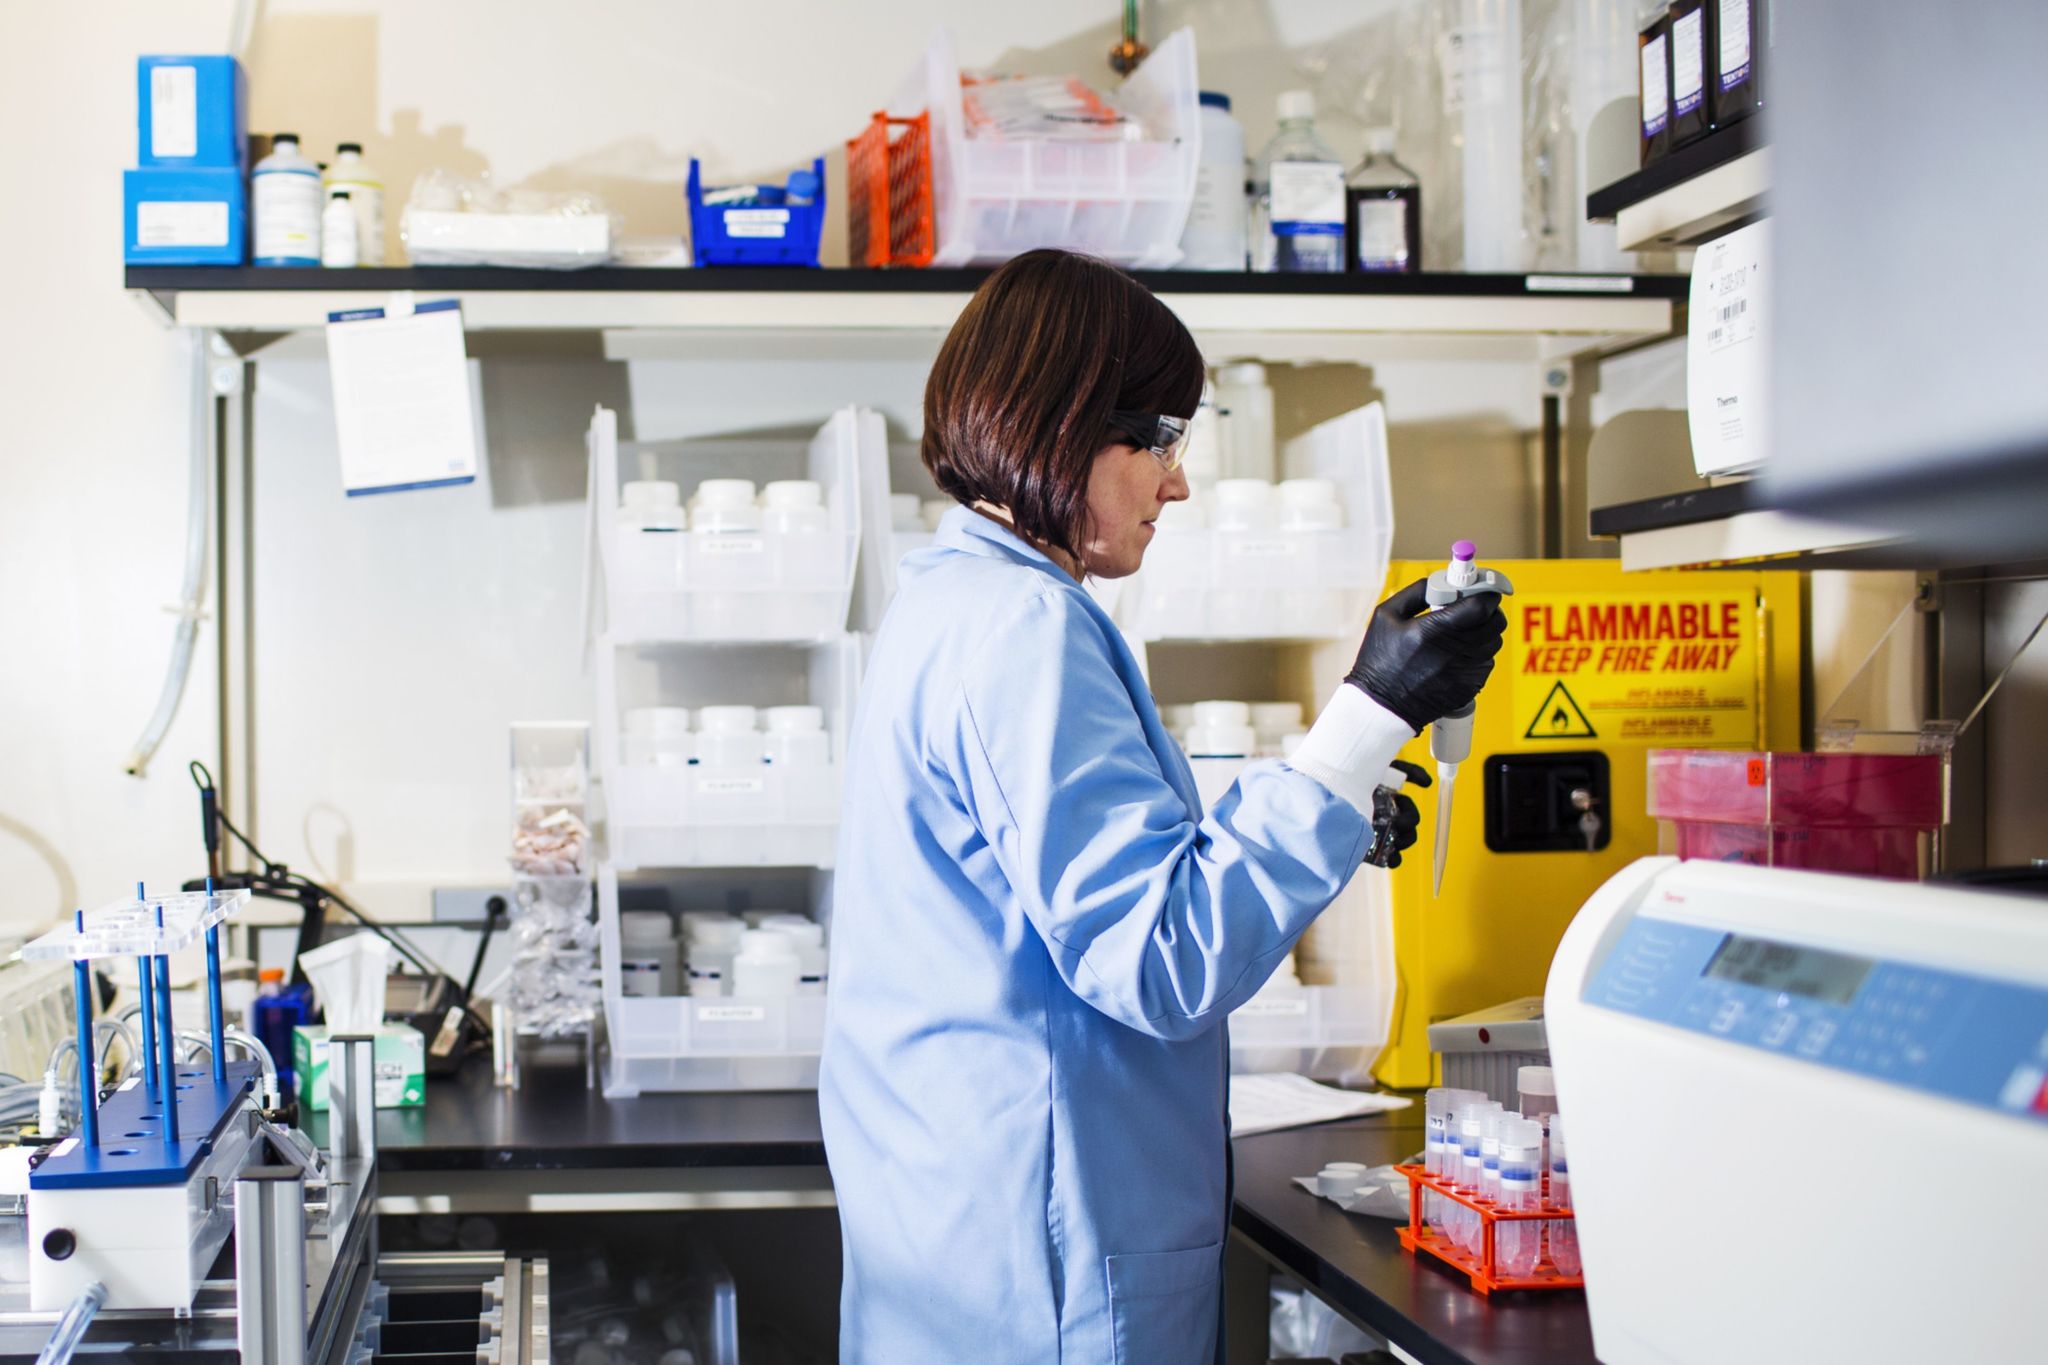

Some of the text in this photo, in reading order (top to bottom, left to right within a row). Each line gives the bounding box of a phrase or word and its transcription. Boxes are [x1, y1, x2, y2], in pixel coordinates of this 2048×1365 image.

[1522, 602, 1740, 643] FLAMMABLE
[1522, 644, 1739, 675] KEEP FIRE AWAY
